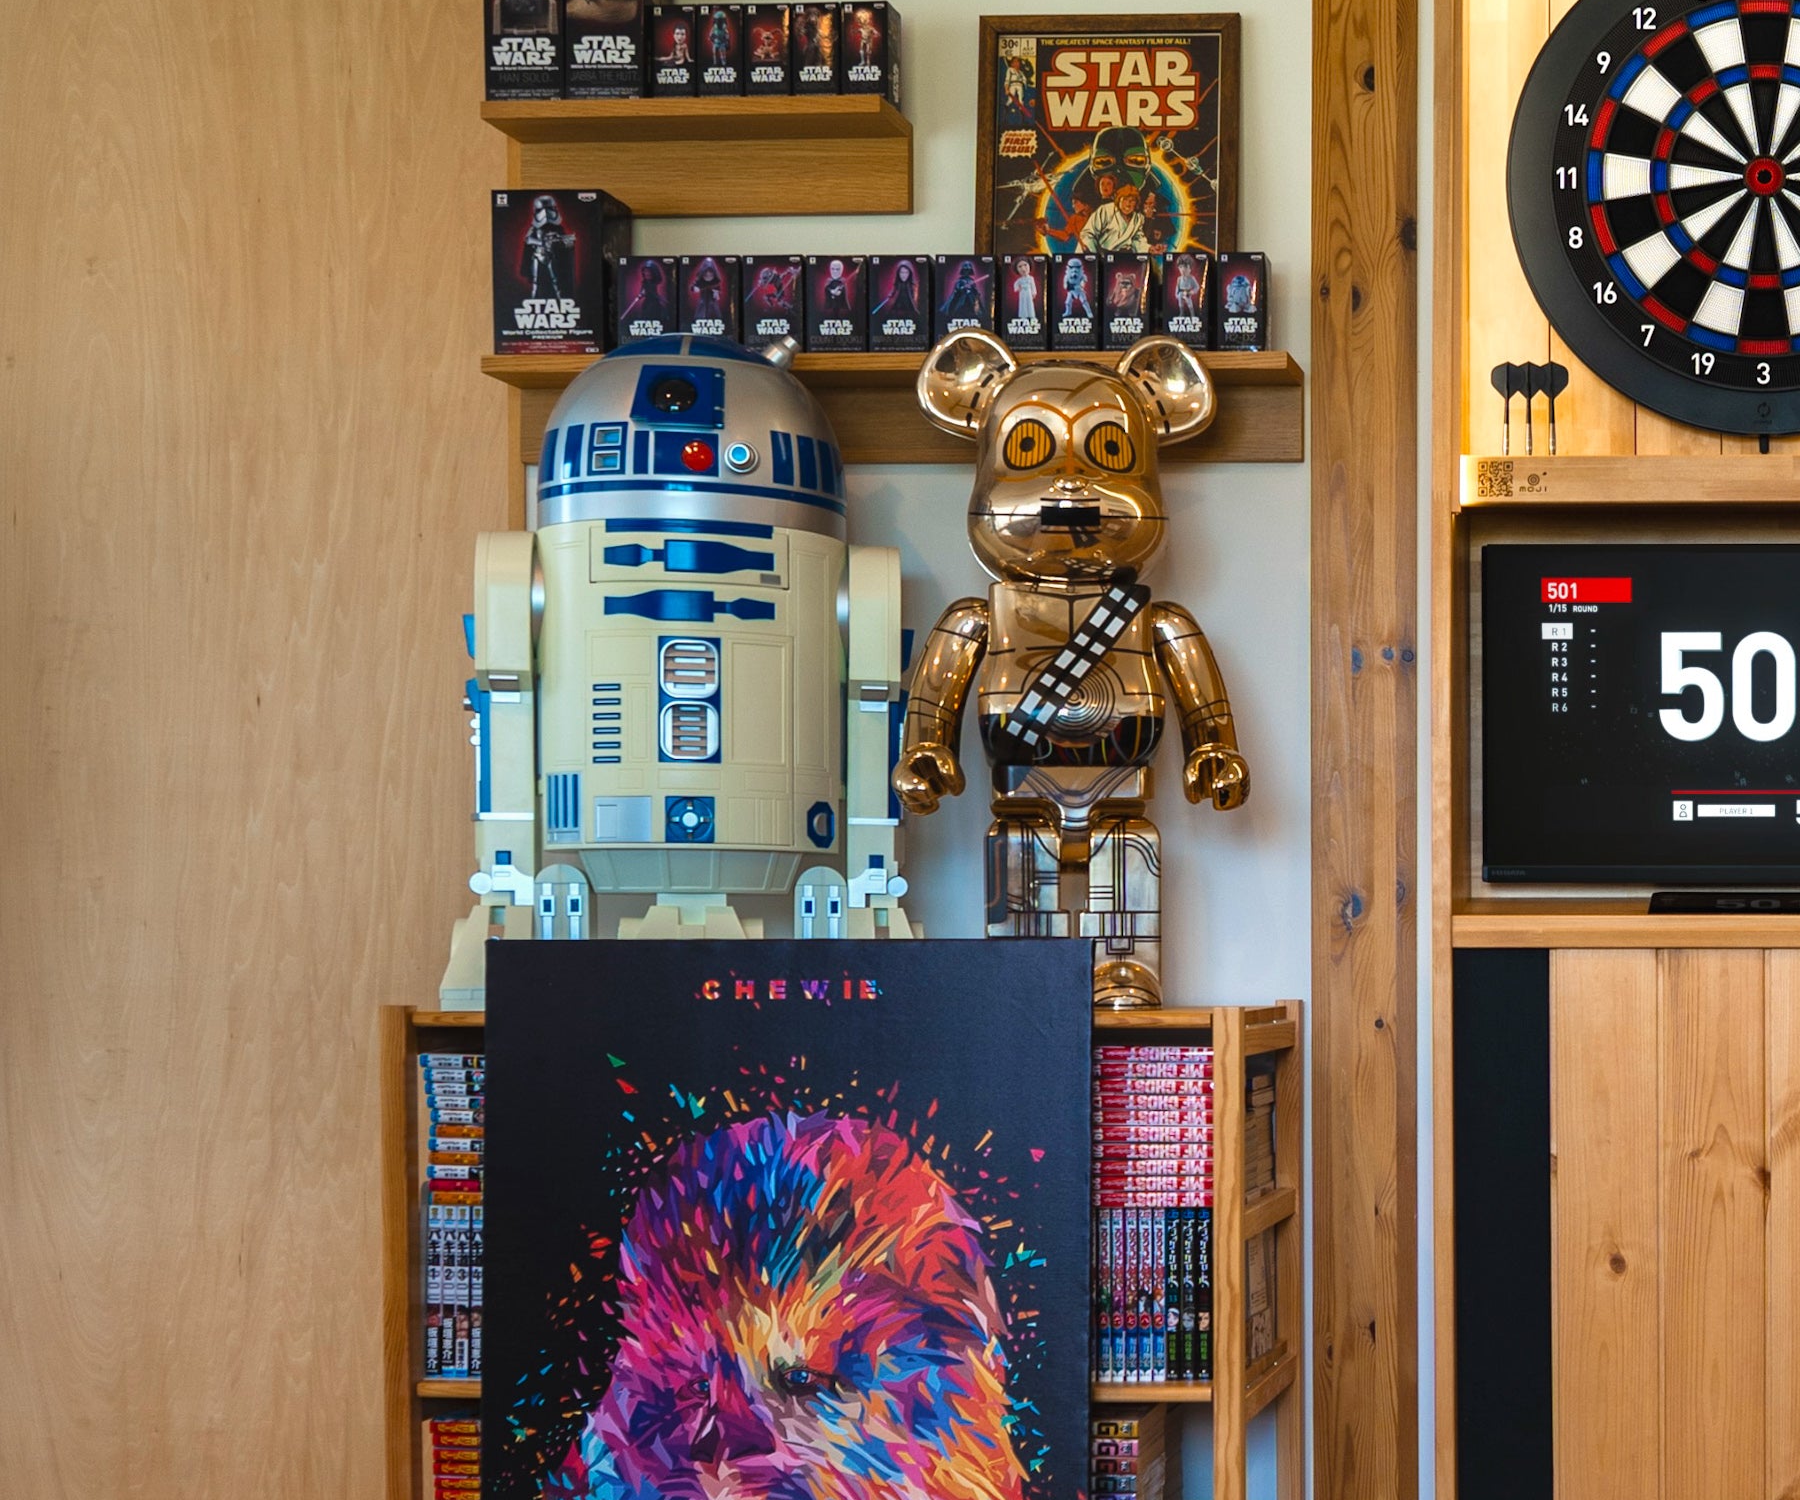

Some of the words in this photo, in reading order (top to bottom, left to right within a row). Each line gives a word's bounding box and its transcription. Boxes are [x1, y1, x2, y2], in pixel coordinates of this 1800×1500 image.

[1632, 7, 1657, 30] 12
[492, 37, 556, 52] STAR
[573, 35, 636, 50] STAR
[492, 51, 556, 66] WARS
[573, 49, 636, 64] WARS
[1596, 51, 1611, 74] 9
[1046, 51, 1196, 87] STAR
[1046, 90, 1196, 127] WARS
[1564, 103, 1589, 127] 14
[1004, 138, 1031, 146] FIRST
[1556, 166, 1578, 190] 11
[1568, 226, 1583, 249] 8
[1593, 281, 1618, 305] 16
[514, 298, 581, 314] STAR
[514, 313, 581, 329] WARS
[819, 319, 853, 328] STAR
[1223, 317, 1258, 326] STAR
[819, 327, 853, 336] WARS
[1223, 325, 1258, 334] WARS
[1640, 324, 1655, 347] 7
[1691, 352, 1715, 375] 19
[1756, 362, 1771, 385] 3
[1547, 582, 1578, 600] 501
[1548, 603, 1568, 613] 1/15
[1572, 605, 1599, 613] ROUND
[1551, 627, 1559, 636] R
[1551, 642, 1559, 652] R
[1561, 642, 1568, 652] 2
[1551, 657, 1559, 667] R
[1561, 657, 1568, 667] 3
[1551, 672, 1559, 682] R
[1561, 672, 1568, 682] 4
[1551, 687, 1559, 697] R
[1561, 687, 1568, 697] 5
[1551, 702, 1559, 713] R
[1561, 702, 1568, 713] 6
[1719, 807, 1747, 815] PLAYER
[702, 979, 877, 1000] CHEWIE
